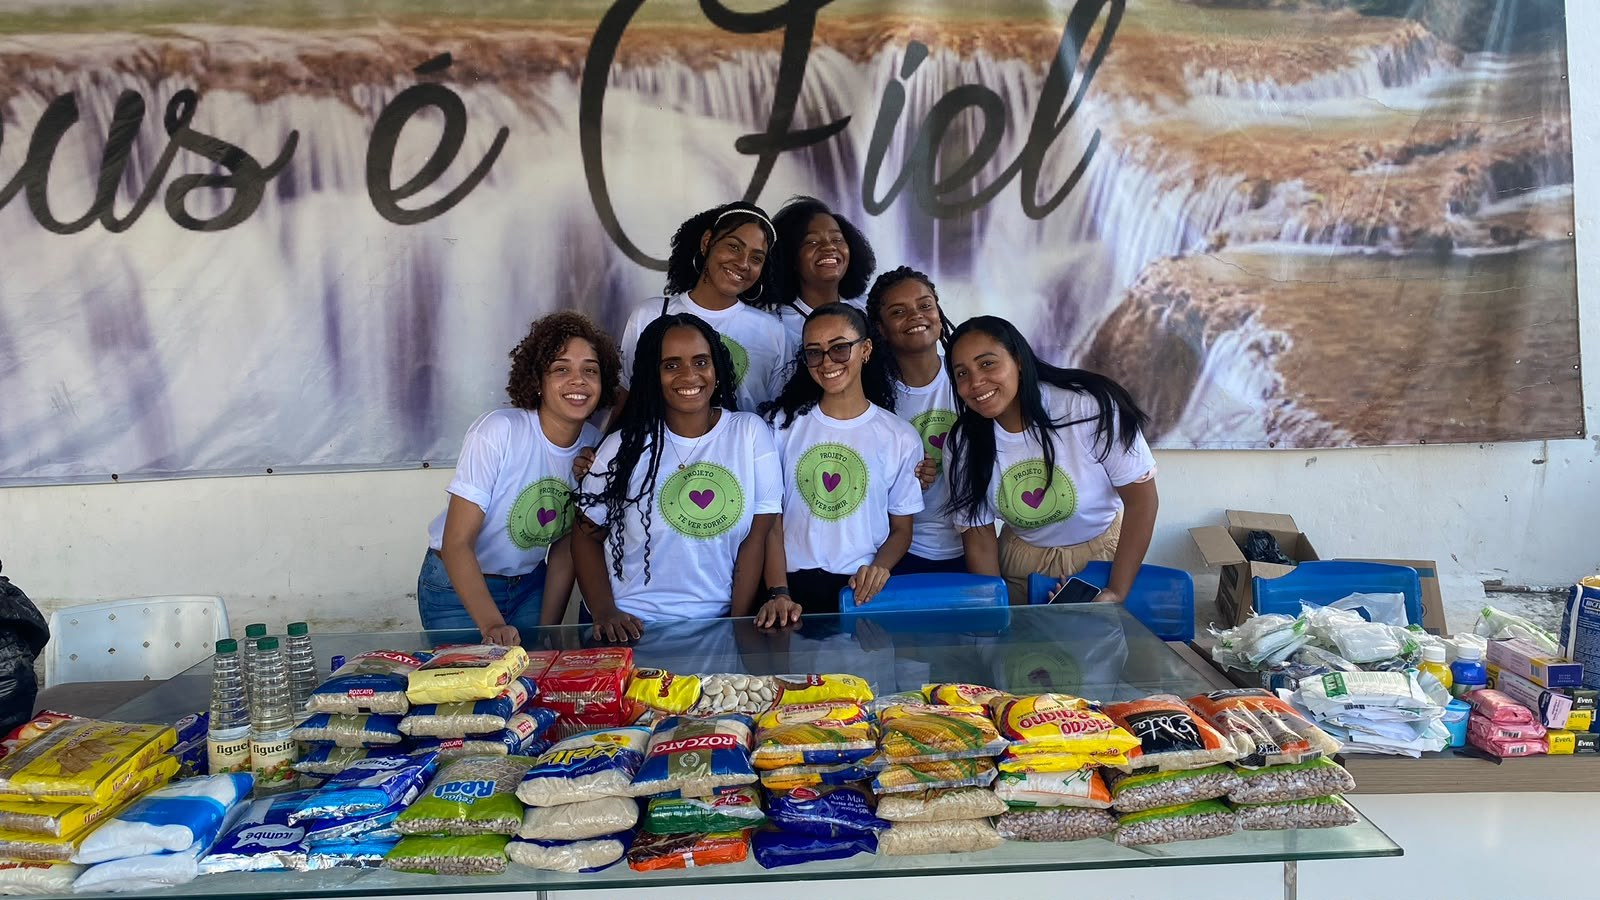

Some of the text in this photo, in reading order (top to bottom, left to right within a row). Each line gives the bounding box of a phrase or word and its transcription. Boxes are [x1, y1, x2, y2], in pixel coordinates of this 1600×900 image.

[0, 0, 1126, 272] us é Fiel
[919, 416, 946, 428] PROJETO
[819, 451, 848, 463] PROJETO
[683, 469, 714, 482] PROJETO
[1013, 467, 1043, 482] PROJETO
[815, 499, 827, 511] VER
[827, 499, 849, 512] SORRIR
[677, 513, 729, 530] TE VER SORRIR
[1014, 509, 1063, 527] TE VER SORRIR
[348, 688, 374, 696] ROZCATO
[253, 739, 296, 757] figueira
[653, 735, 735, 754] ROZCATO
[433, 779, 496, 798] Real
[847, 793, 865, 804] Mar
